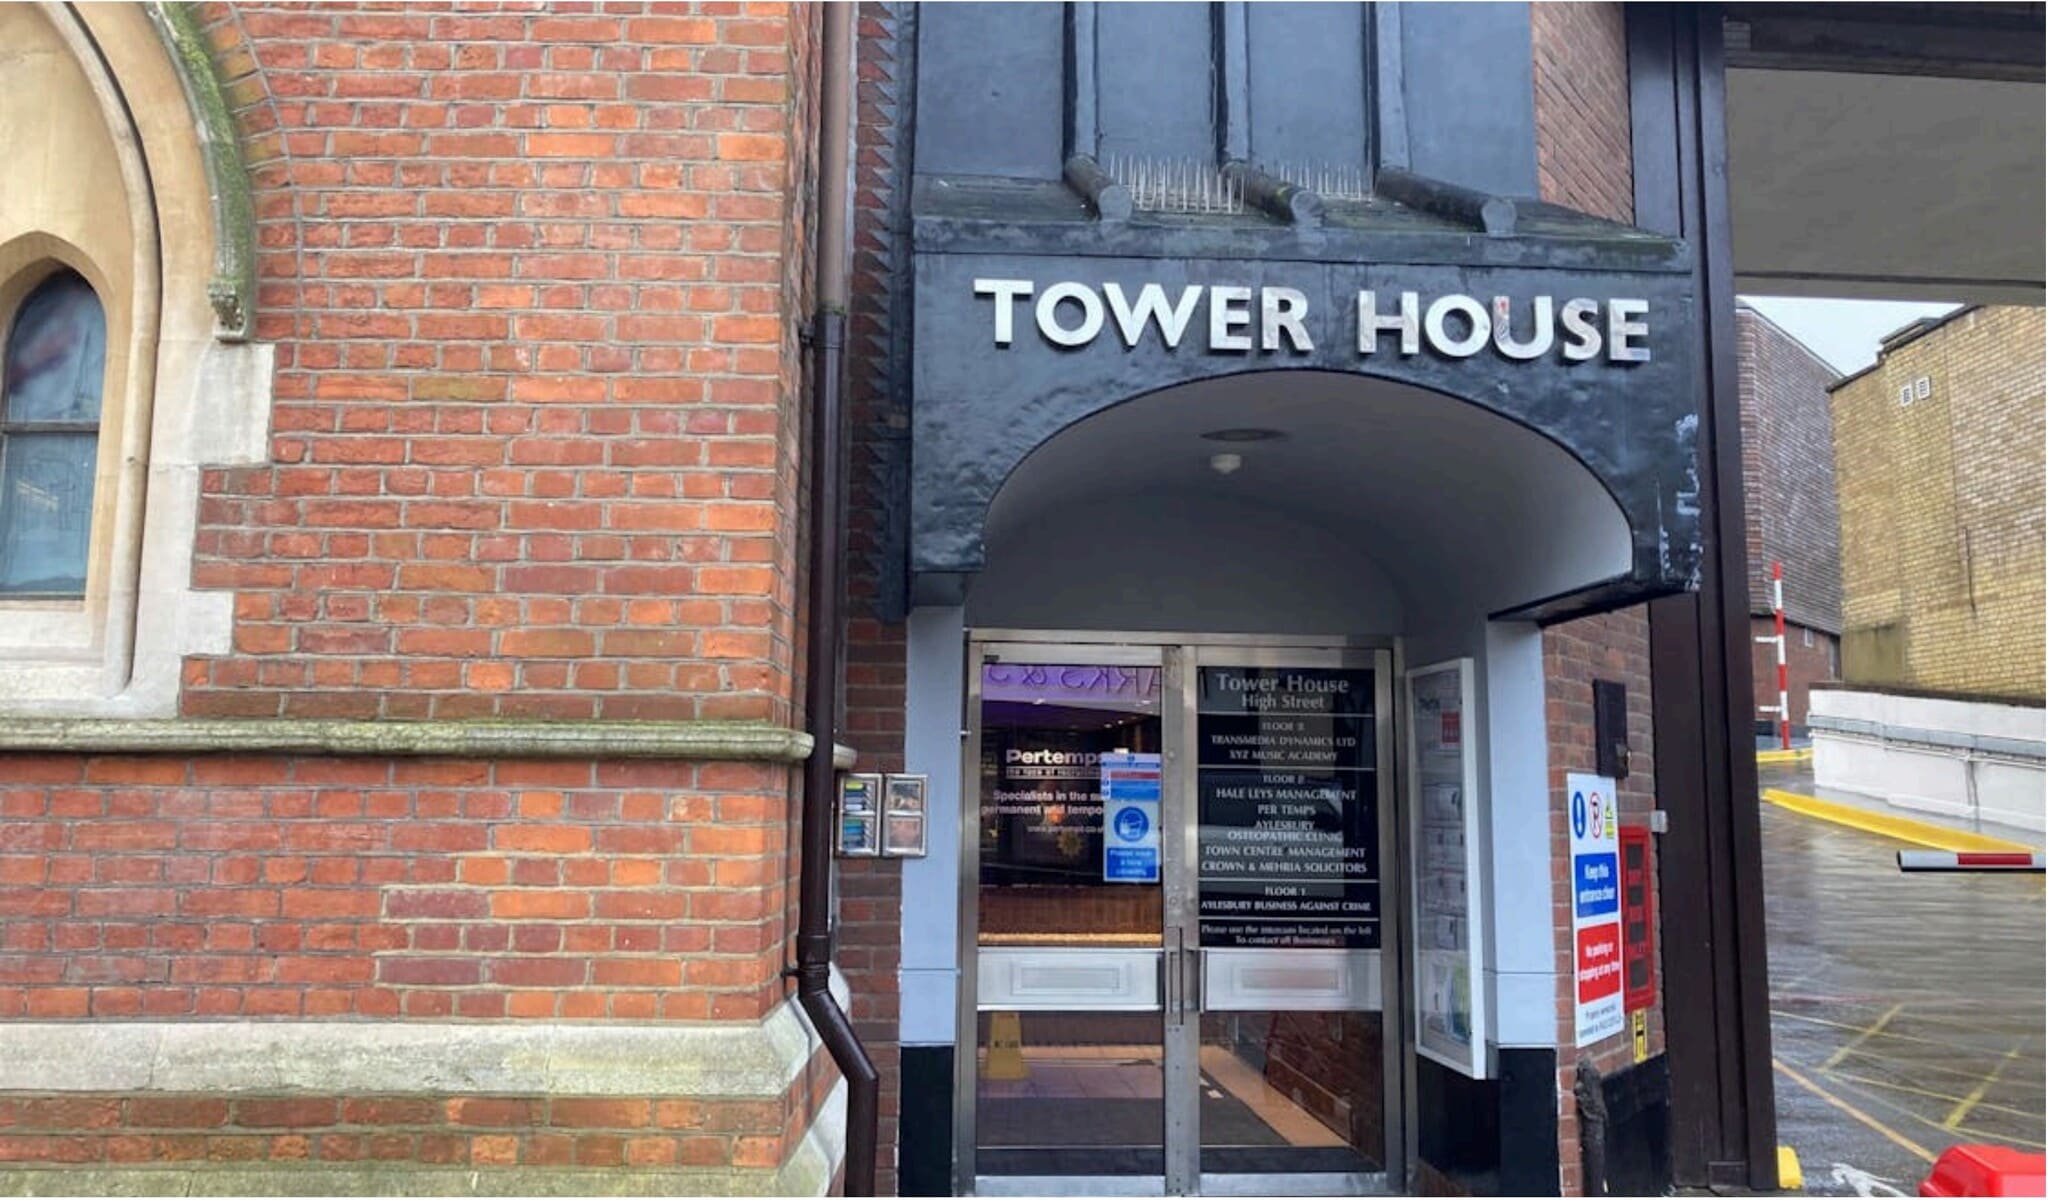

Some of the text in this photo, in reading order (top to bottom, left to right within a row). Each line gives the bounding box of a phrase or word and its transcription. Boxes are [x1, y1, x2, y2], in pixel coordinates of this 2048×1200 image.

[973, 278, 1652, 361] TOWER HOUSE
[1216, 673, 1350, 693] Tower House
[1241, 693, 1325, 710] High Street
[1261, 721, 1294, 731] FLOOR
[1211, 734, 1356, 748] TRANSMEDIA DYNAMICS LTD
[1229, 749, 1338, 762] XYZ MUSIC ACADEMY
[1263, 774, 1295, 784] FLOOR
[993, 790, 1053, 802] Specialists
[1055, 790, 1067, 801] in
[1069, 791, 1088, 801] the
[1215, 787, 1357, 801] HALE LEYS MANAGEMENT
[981, 804, 1042, 816] permanent
[1067, 805, 1104, 817] tempo
[1257, 803, 1317, 816] PER TEMPS
[1254, 820, 1315, 830] AYLESBURY
[1227, 830, 1343, 843] OSTEOPATHIC CLINIC
[1205, 845, 1367, 858] TOWN CENTRE MANAGEMENT
[1201, 860, 1245, 872] CROWN
[1247, 861, 1256, 872] &
[1304, 862, 1368, 874] SOLICITORS
[1265, 886, 1298, 896] FLOOR
[1201, 900, 1372, 912] AYLESBURY BUSINESS AGAINST CRIME
